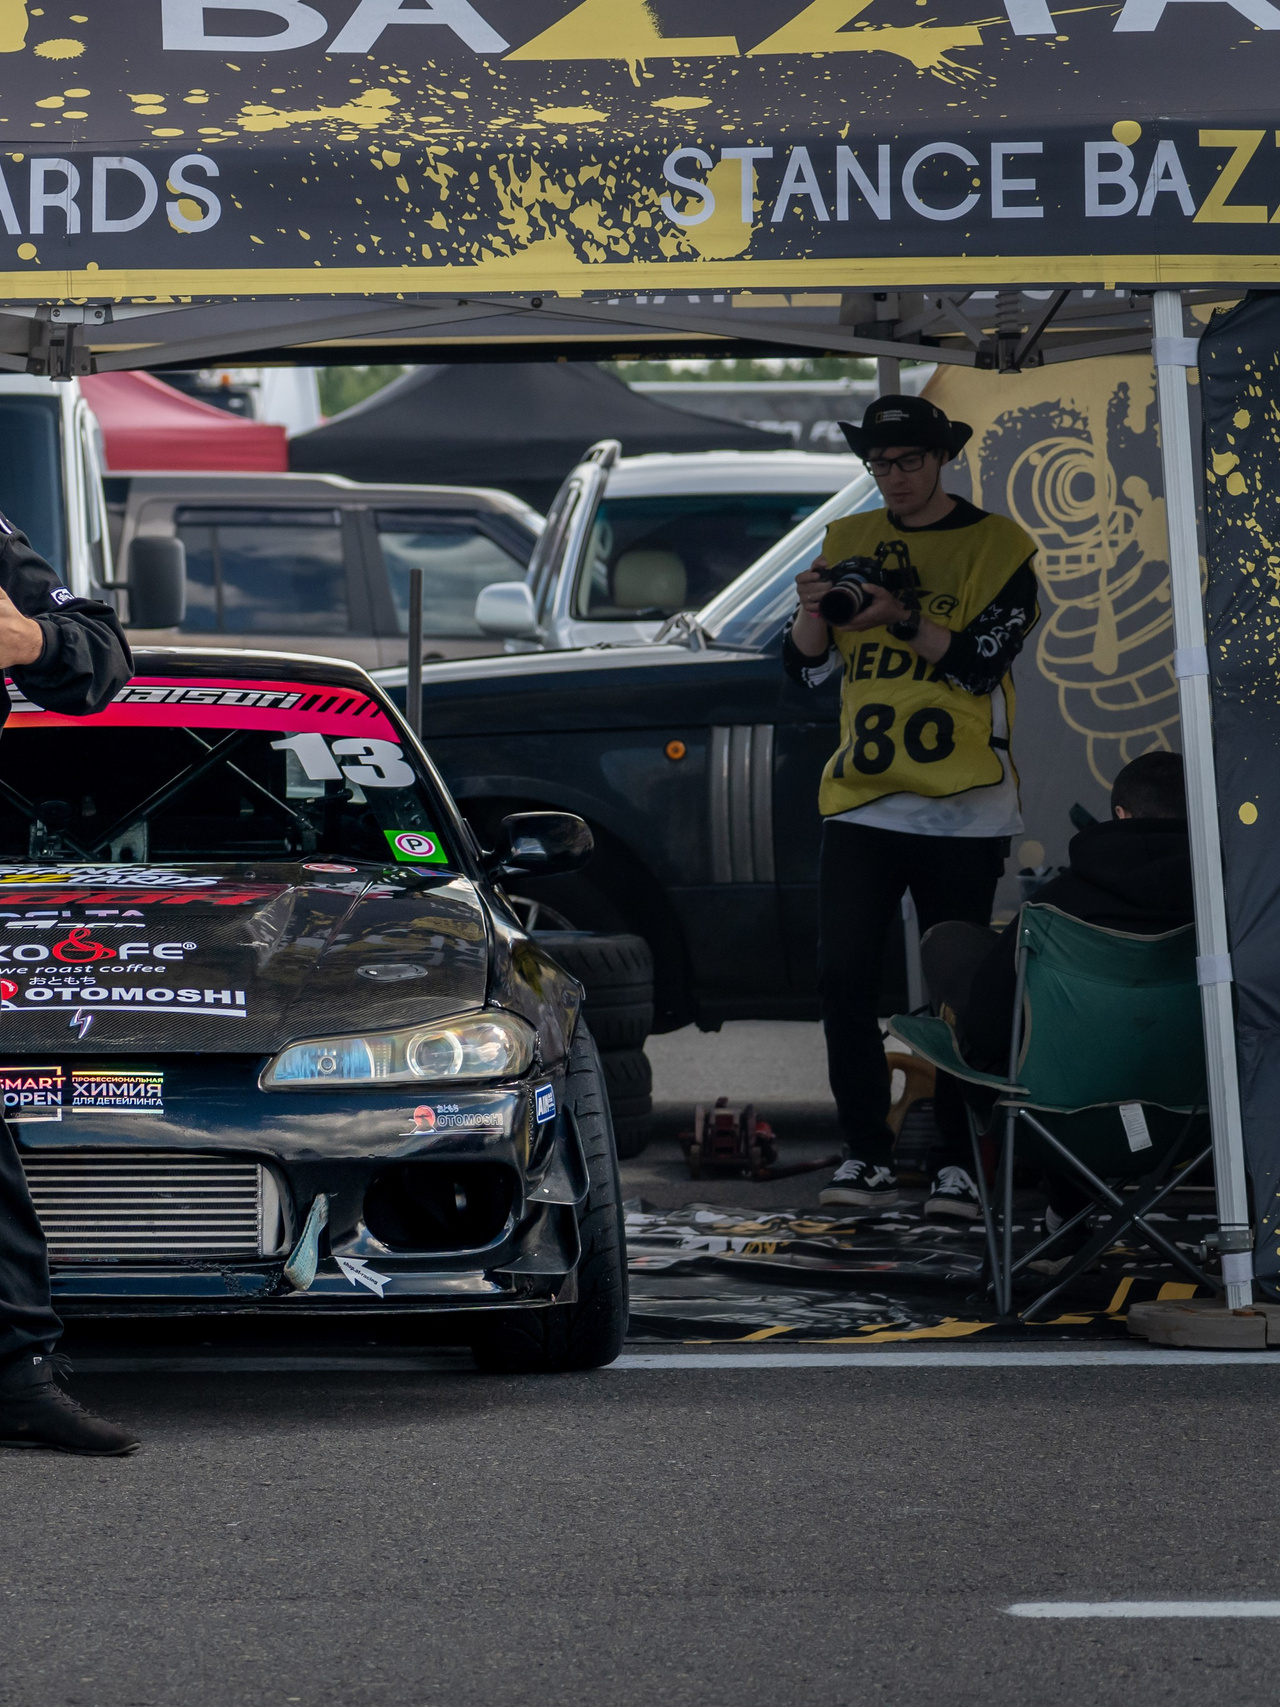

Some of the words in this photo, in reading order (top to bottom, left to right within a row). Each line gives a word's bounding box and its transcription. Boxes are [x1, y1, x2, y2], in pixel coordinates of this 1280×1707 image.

[662, 140, 1044, 227] STANCE
[1085, 129, 1280, 224] BAZ
[844, 642, 943, 684] EDI
[270, 732, 416, 787] 13
[406, 838, 422, 850] P
[35, 965, 93, 974] roast
[99, 963, 166, 973] coffee
[29, 976, 96, 986] おともち
[24, 987, 246, 1005] OTOMOSHI
[72, 1083, 162, 1097] ХИМИЯ
[4, 1092, 62, 1106] OPEN
[72, 1097, 94, 1105] ДЛЯ
[96, 1096, 163, 1106] ДЕТЕЙЛИНГА
[437, 1113, 504, 1127] OTOMOSHI
